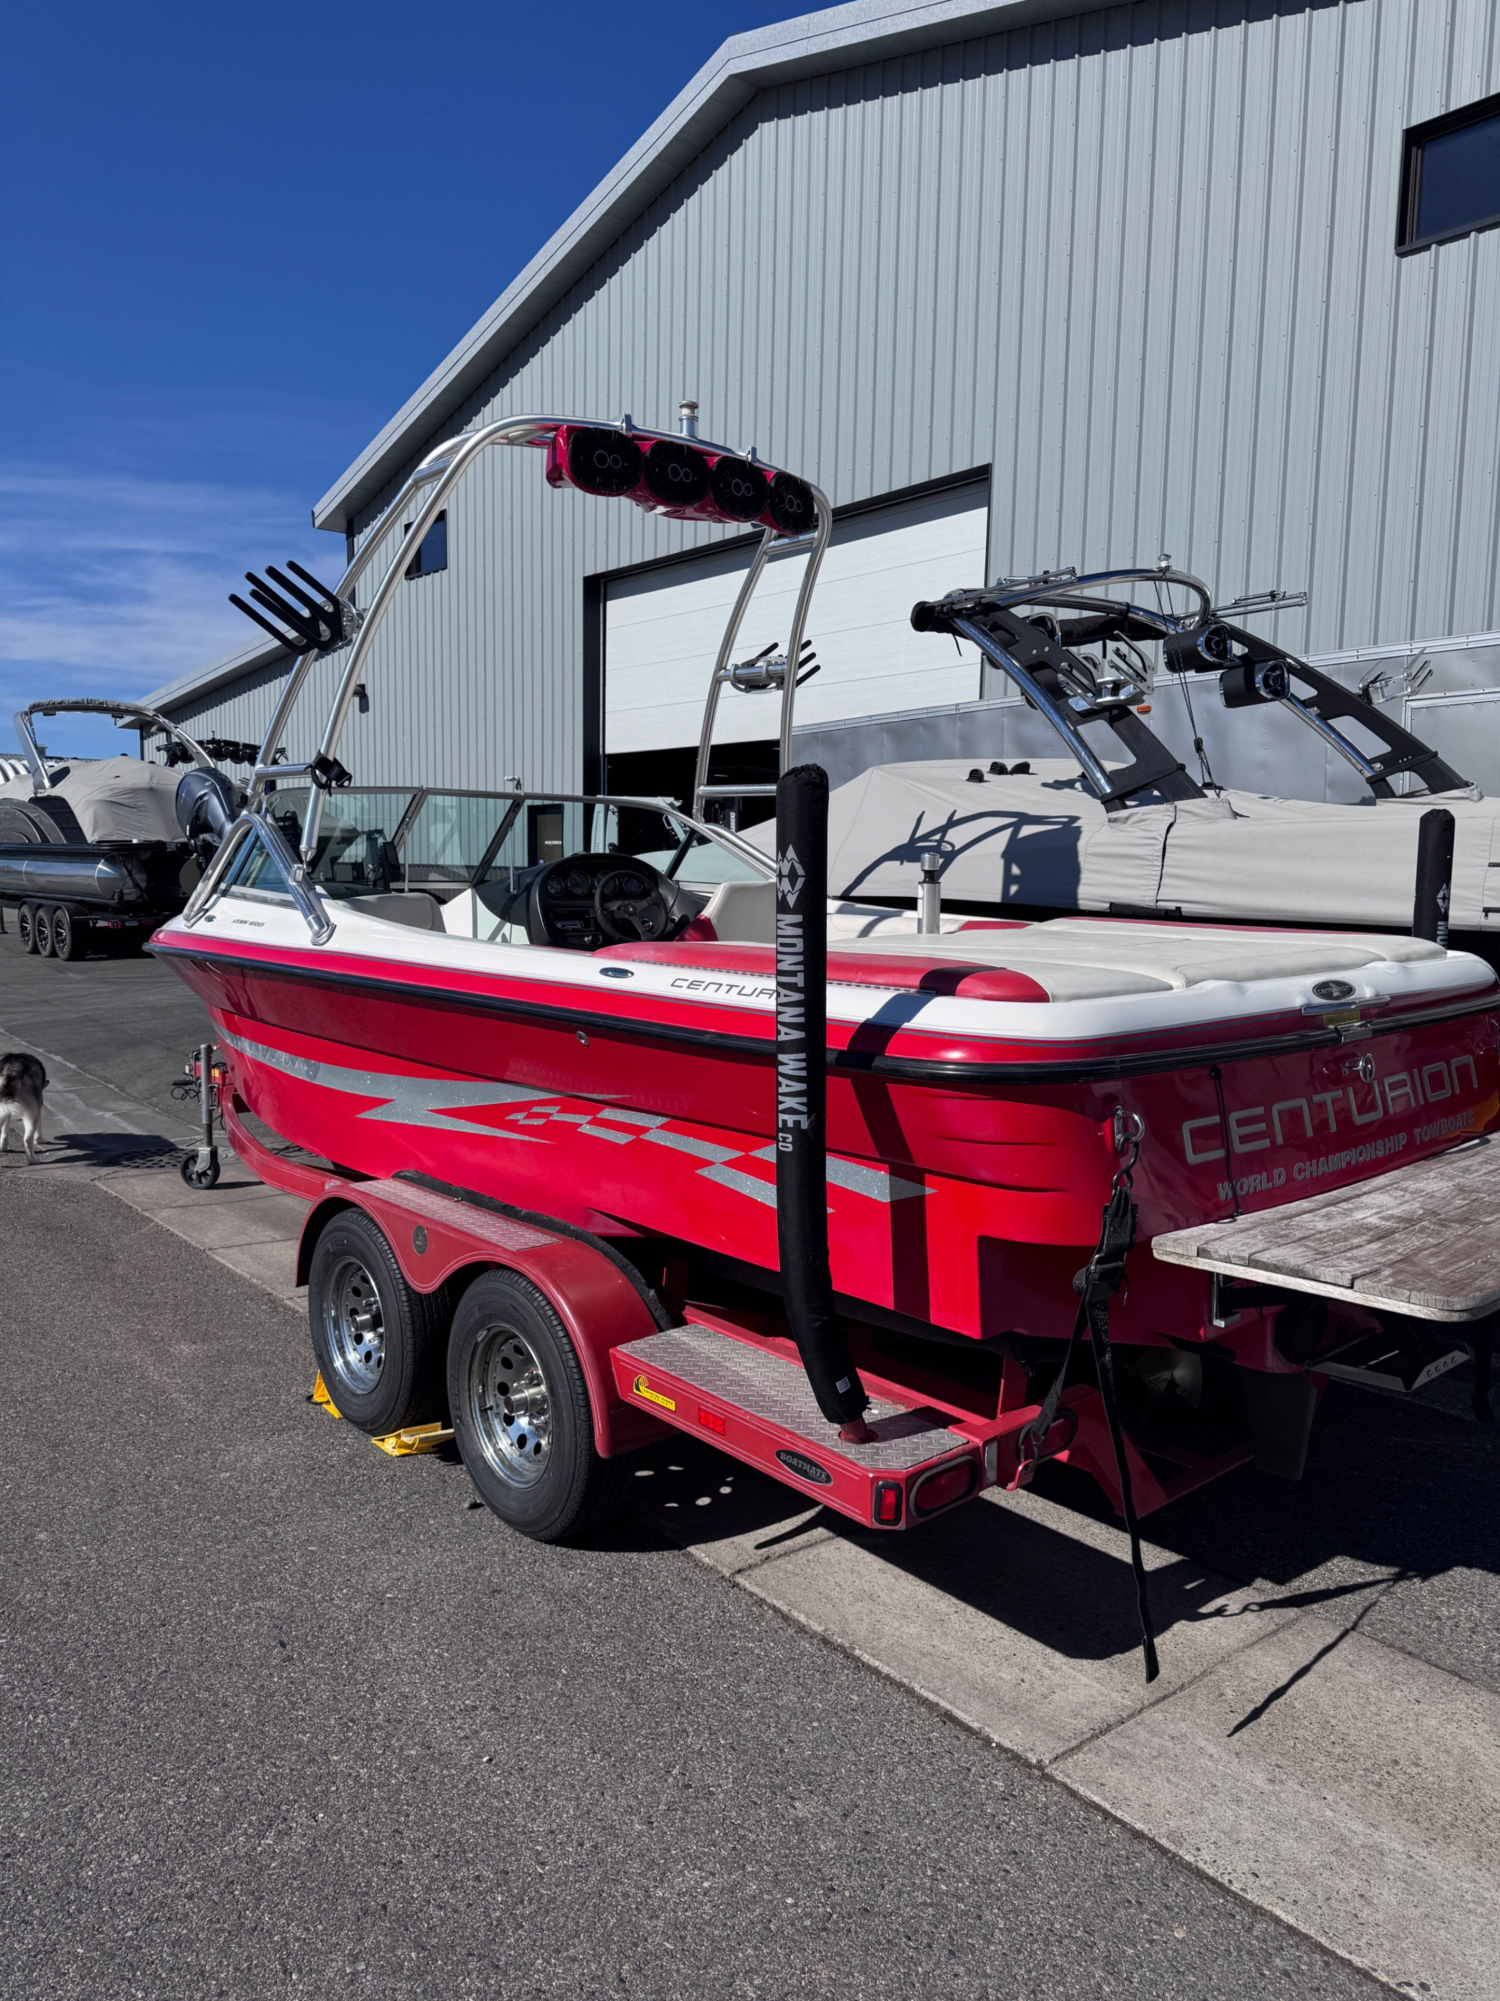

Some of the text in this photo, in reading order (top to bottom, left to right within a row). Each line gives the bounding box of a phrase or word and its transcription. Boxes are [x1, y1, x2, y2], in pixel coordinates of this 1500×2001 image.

[776, 913, 808, 1152] MONTANA WAKE CO
[1181, 1054, 1479, 1165] CENTURION
[1217, 1110, 1476, 1201] WORLD CHAMPIONSHIP TOWBOATS
[779, 1451, 828, 1480] BOATMATE
